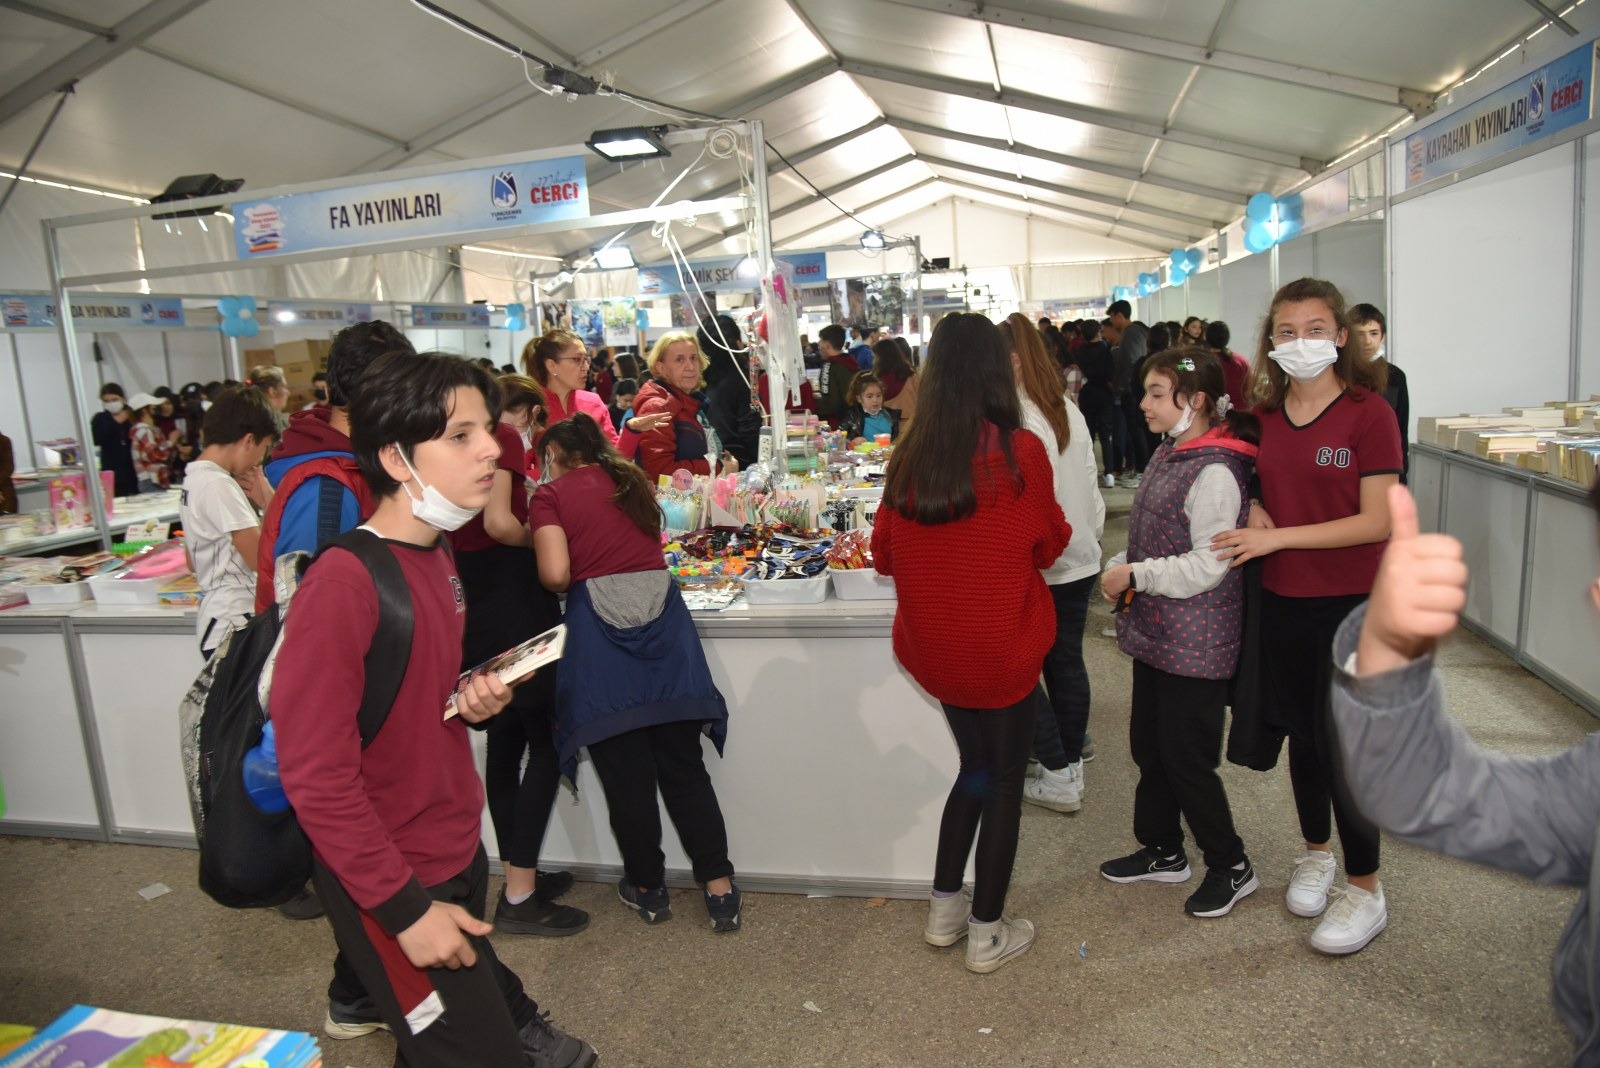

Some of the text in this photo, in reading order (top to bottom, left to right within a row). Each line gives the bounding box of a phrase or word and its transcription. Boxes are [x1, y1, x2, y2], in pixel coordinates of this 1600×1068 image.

[1426, 122, 1471, 164] KAYRAHAN
[1475, 97, 1528, 144] YAYINLARI
[329, 192, 442, 230] FA YAYINLARI
